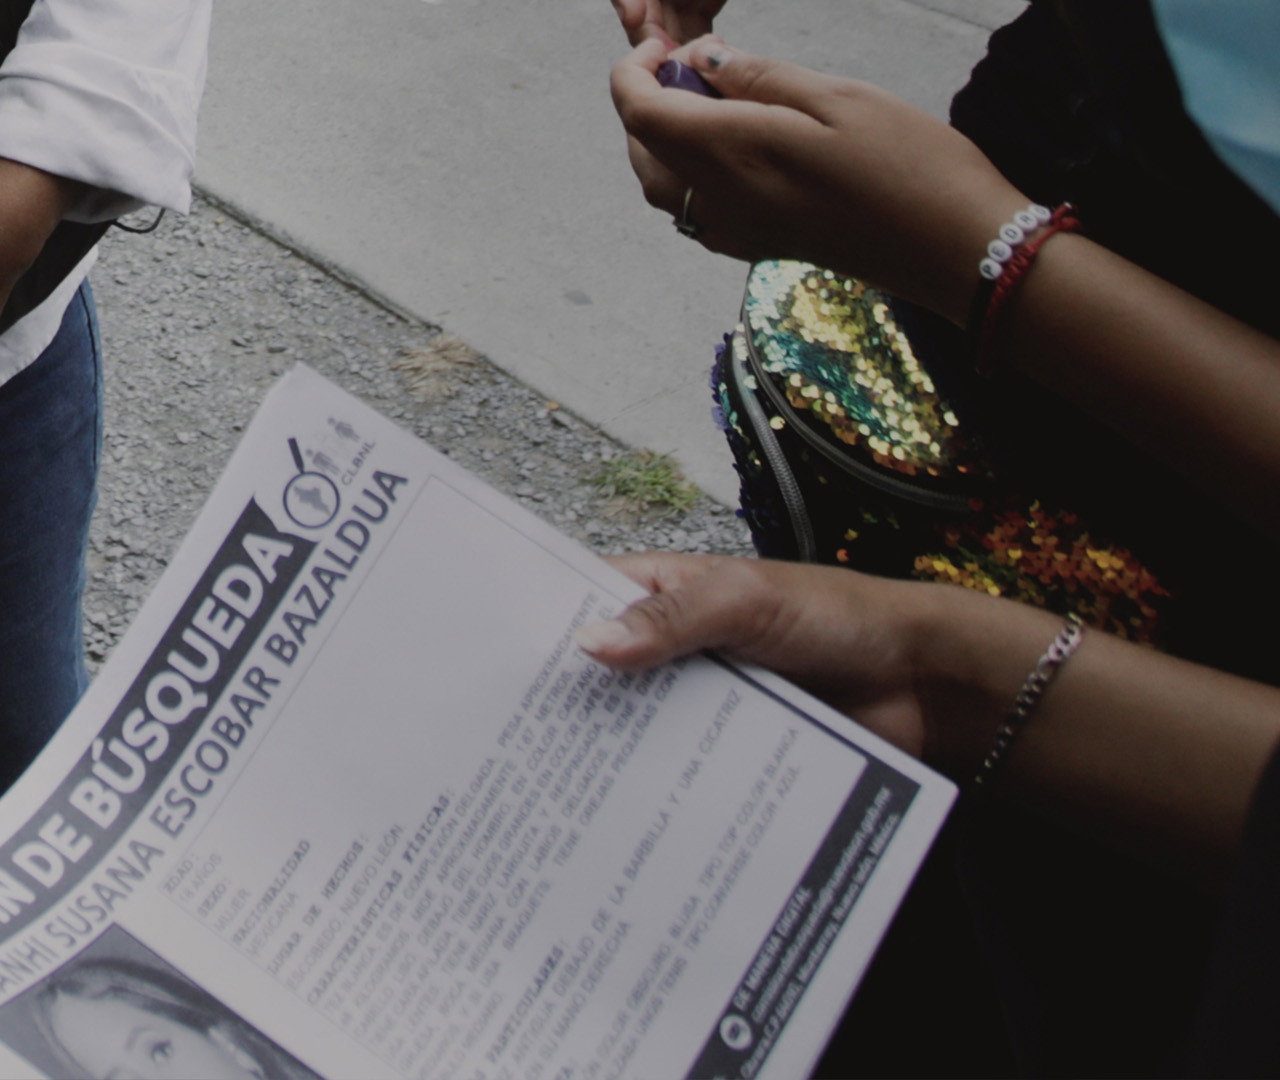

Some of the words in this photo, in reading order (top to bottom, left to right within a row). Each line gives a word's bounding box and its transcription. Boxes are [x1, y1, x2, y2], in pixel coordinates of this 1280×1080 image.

[340, 439, 376, 487] CLBNL
[14, 813, 95, 905] DE
[69, 532, 295, 837] BÚSQUEDA
[48, 840, 165, 952] SUSANA
[149, 666, 280, 840] ESCOBAR
[264, 469, 410, 666] BAZALDUA
[509, 773, 530, 796] EN
[522, 723, 561, 772] COLOR
[553, 659, 600, 721] CASTAÑO
[692, 686, 746, 756] CICATRIZ
[495, 787, 544, 852] GRANDES
[534, 767, 555, 789] EN
[545, 721, 583, 770] COLOR
[664, 790, 683, 808] Y
[673, 755, 705, 792] UNA
[398, 815, 462, 901] COMPLEXIÓN
[494, 711, 525, 748] PESA
[409, 887, 439, 923] MIDE
[431, 758, 520, 884] APROXIMADAMENTE
[618, 808, 675, 881] BARBILLA
[230, 835, 313, 949] NACIONALIDAD
[337, 861, 380, 916] NUEVO
[587, 905, 614, 934] DE
[605, 879, 630, 906] LA
[770, 882, 816, 939] DIGITAL
[548, 933, 597, 997] DEBAJO
[740, 933, 786, 991] MANERA
[730, 987, 754, 1012] DE
